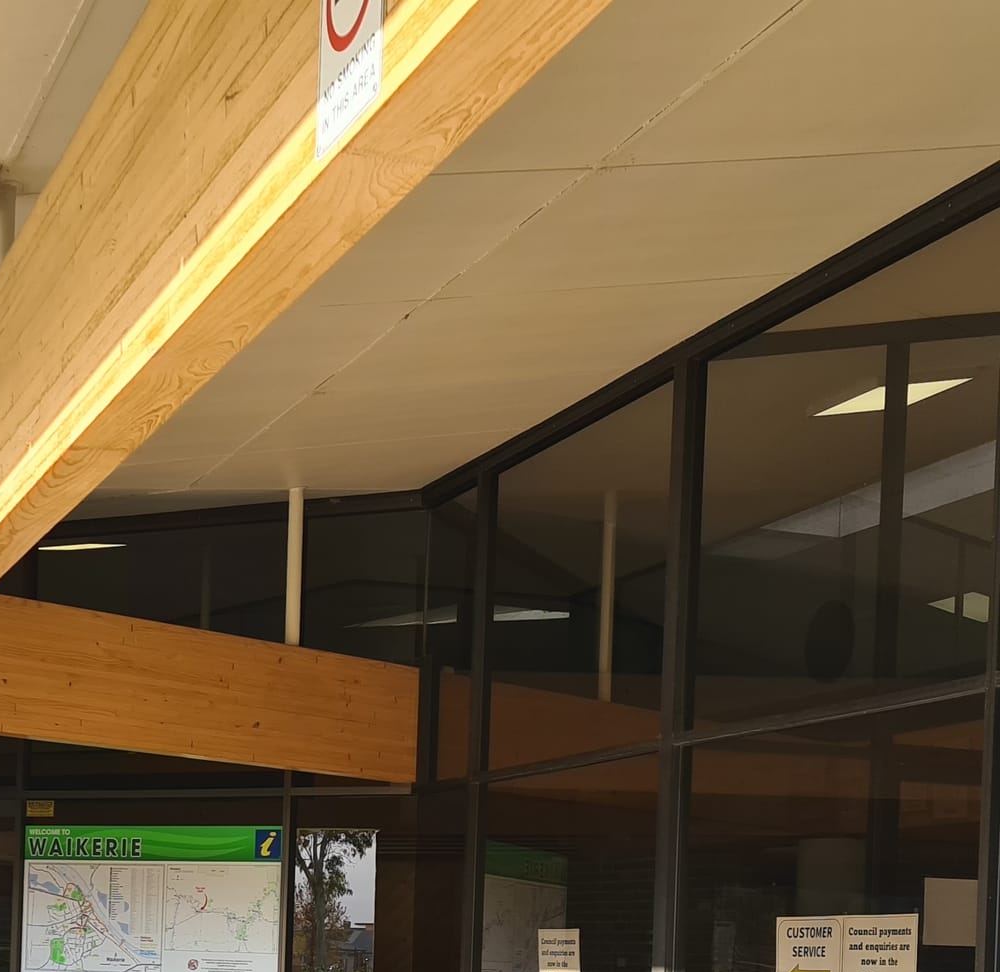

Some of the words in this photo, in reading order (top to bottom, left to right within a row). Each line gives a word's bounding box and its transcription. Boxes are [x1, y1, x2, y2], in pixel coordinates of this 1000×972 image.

[323, 80, 336, 102] NO
[337, 33, 376, 90] SMOKING
[332, 92, 350, 124] THIS
[352, 64, 376, 98] AREA
[29, 828, 61, 836] WELCOME
[62, 828, 71, 836] TO
[27, 836, 142, 858] WAIKERIE
[787, 927, 833, 938] CUSTOMER
[848, 927, 877, 935] Council
[879, 928, 912, 938] payments
[792, 946, 826, 957] SERVICE
[849, 942, 863, 950] and
[865, 942, 898, 952] enquiries
[879, 957, 886, 966] in
[888, 957, 898, 966] the
